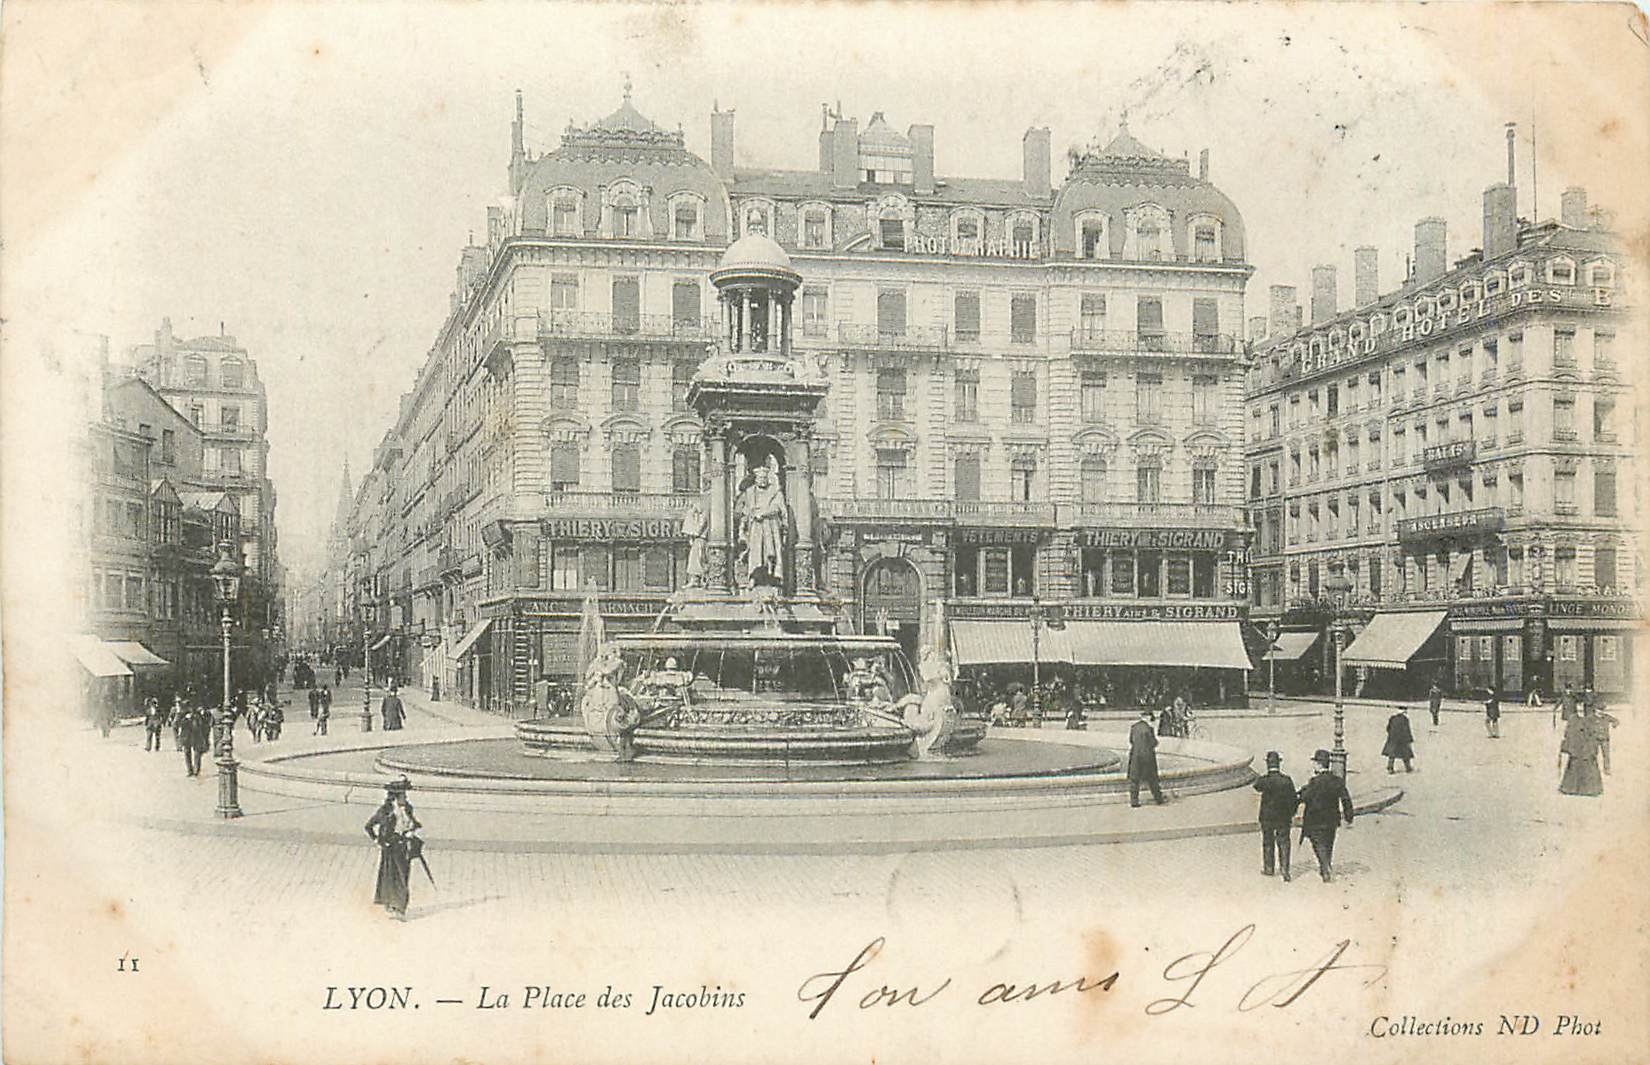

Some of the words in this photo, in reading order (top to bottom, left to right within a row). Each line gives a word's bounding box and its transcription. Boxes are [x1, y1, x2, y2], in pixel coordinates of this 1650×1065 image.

[1301, 337, 1376, 374] GRAND
[1511, 288, 1562, 307] DES
[549, 518, 612, 538] THIERY
[630, 519, 688, 538] SIGRA
[1086, 530, 1140, 547] THIERY
[1158, 531, 1224, 548] SIGRAND
[1062, 606, 1122, 618] THIERY
[1165, 606, 1239, 618] SIGRAND
[1550, 604, 1583, 615] LINGE
